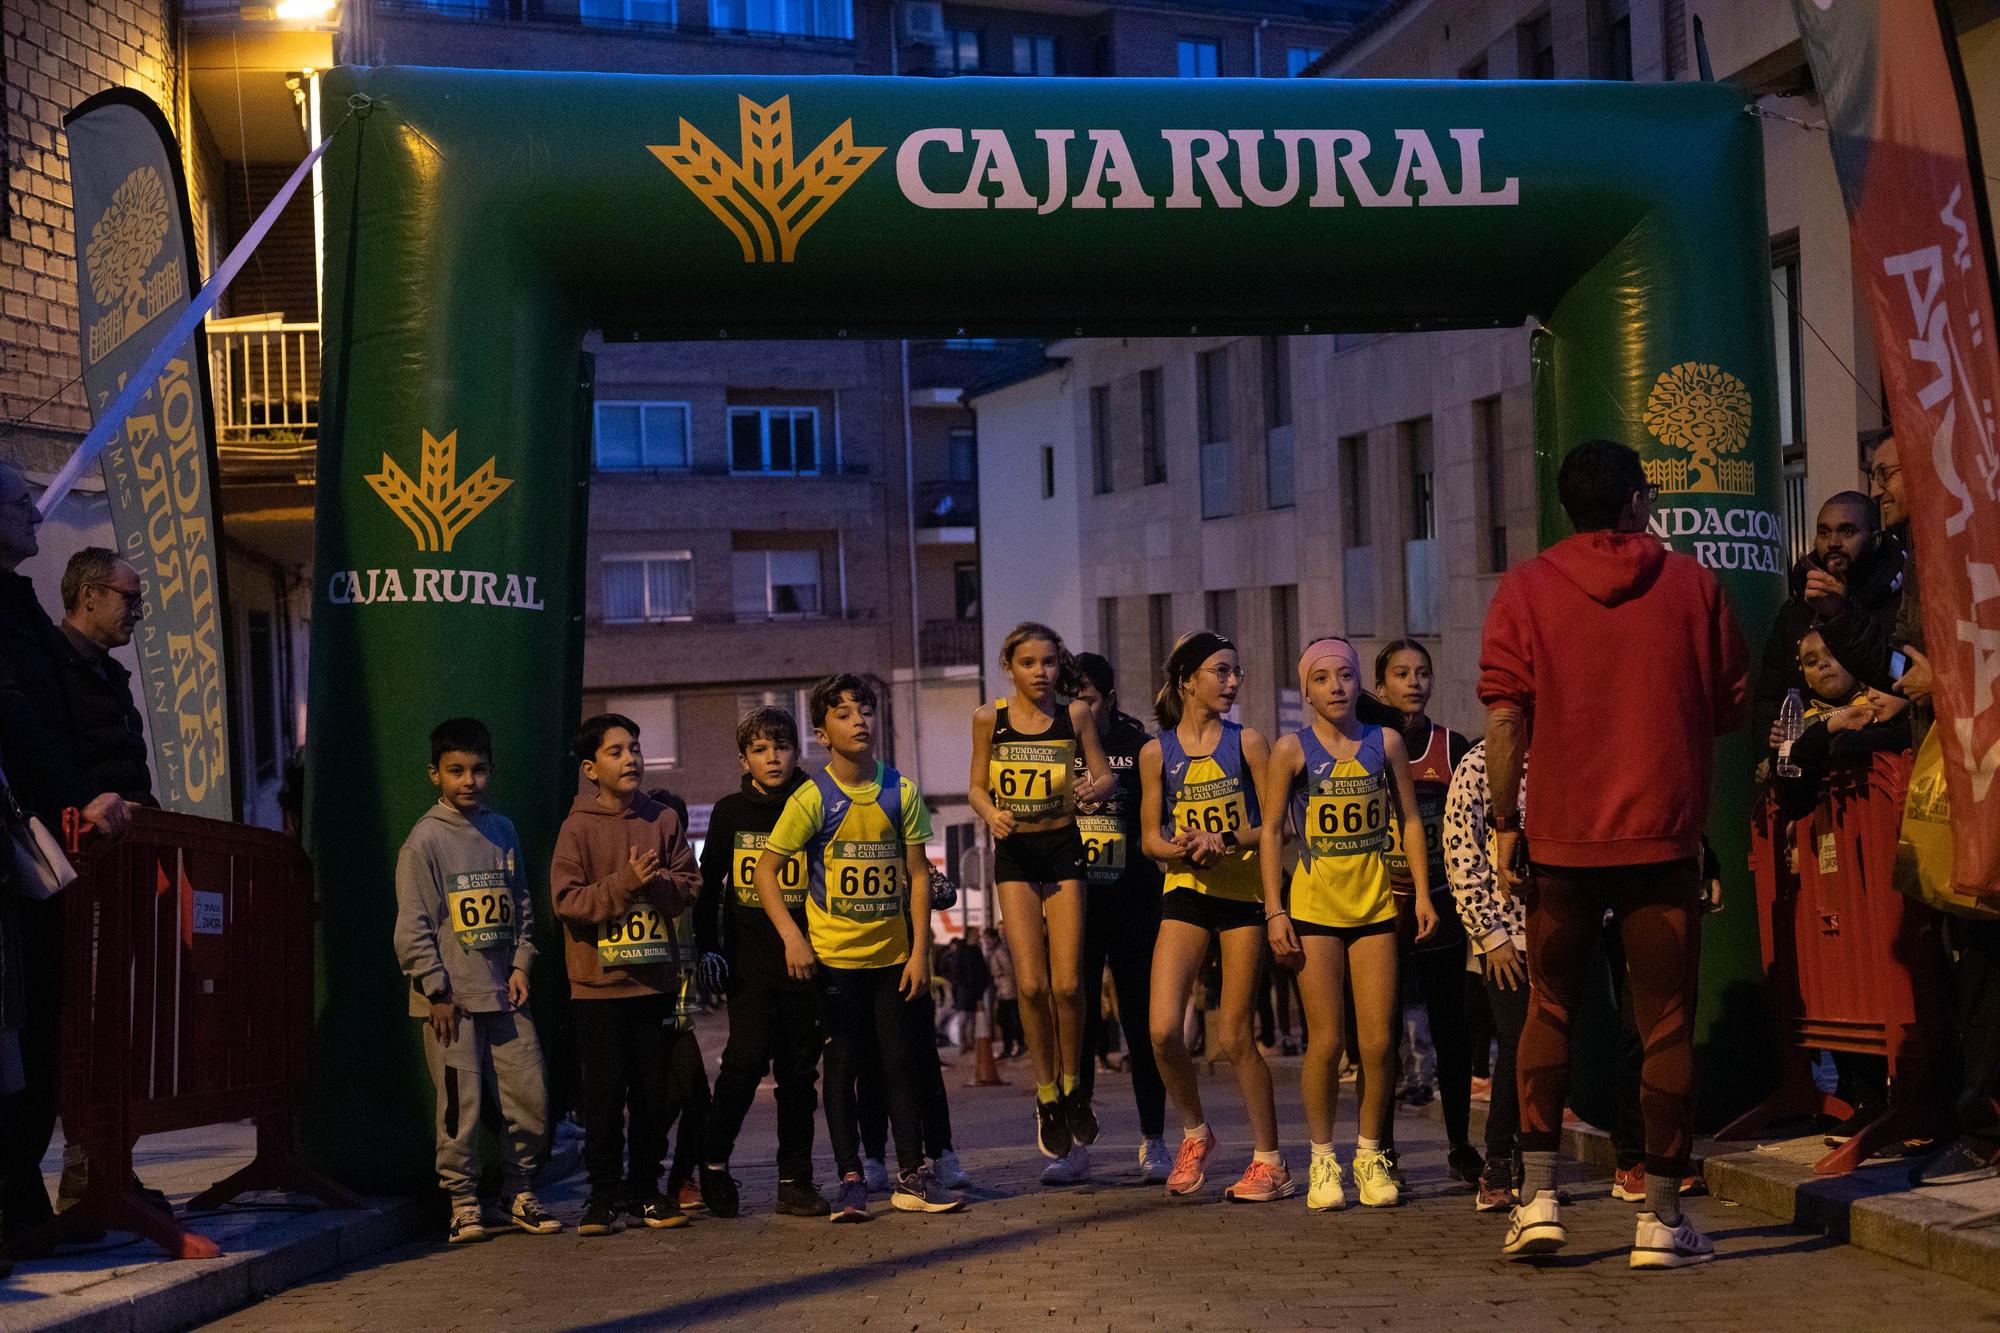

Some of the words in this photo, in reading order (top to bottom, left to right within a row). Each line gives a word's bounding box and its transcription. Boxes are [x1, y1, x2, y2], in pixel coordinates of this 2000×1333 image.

[896, 128, 1155, 215] CAJA
[1161, 128, 1520, 209] RURAL
[1645, 507, 1783, 545] NDACION
[1693, 541, 1785, 576] RURAL
[328, 568, 408, 605] CAJA
[412, 568, 545, 611] RURAL
[1030, 754, 1056, 762] RURAL
[1108, 756, 1133, 767] XAS
[1000, 768, 1052, 797] 671
[1191, 778, 1234, 793] FUNDACION
[1193, 792, 1212, 800] CAJA
[1212, 786, 1234, 797] RURAL
[1335, 787, 1354, 795] CAJA
[1010, 804, 1031, 812] CAJA
[1186, 801, 1240, 833] 665
[1319, 799, 1380, 834] 666
[1083, 838, 1114, 865] 61
[1335, 842, 1358, 850] CAJA
[740, 857, 799, 887] 60
[840, 865, 897, 896] 663
[471, 880, 488, 888] CAJA
[460, 893, 511, 927] 626
[854, 904, 875, 912] CAJA
[480, 931, 498, 941] CAJA
[620, 949, 643, 959] CAJA
[644, 947, 668, 956] RURAL
